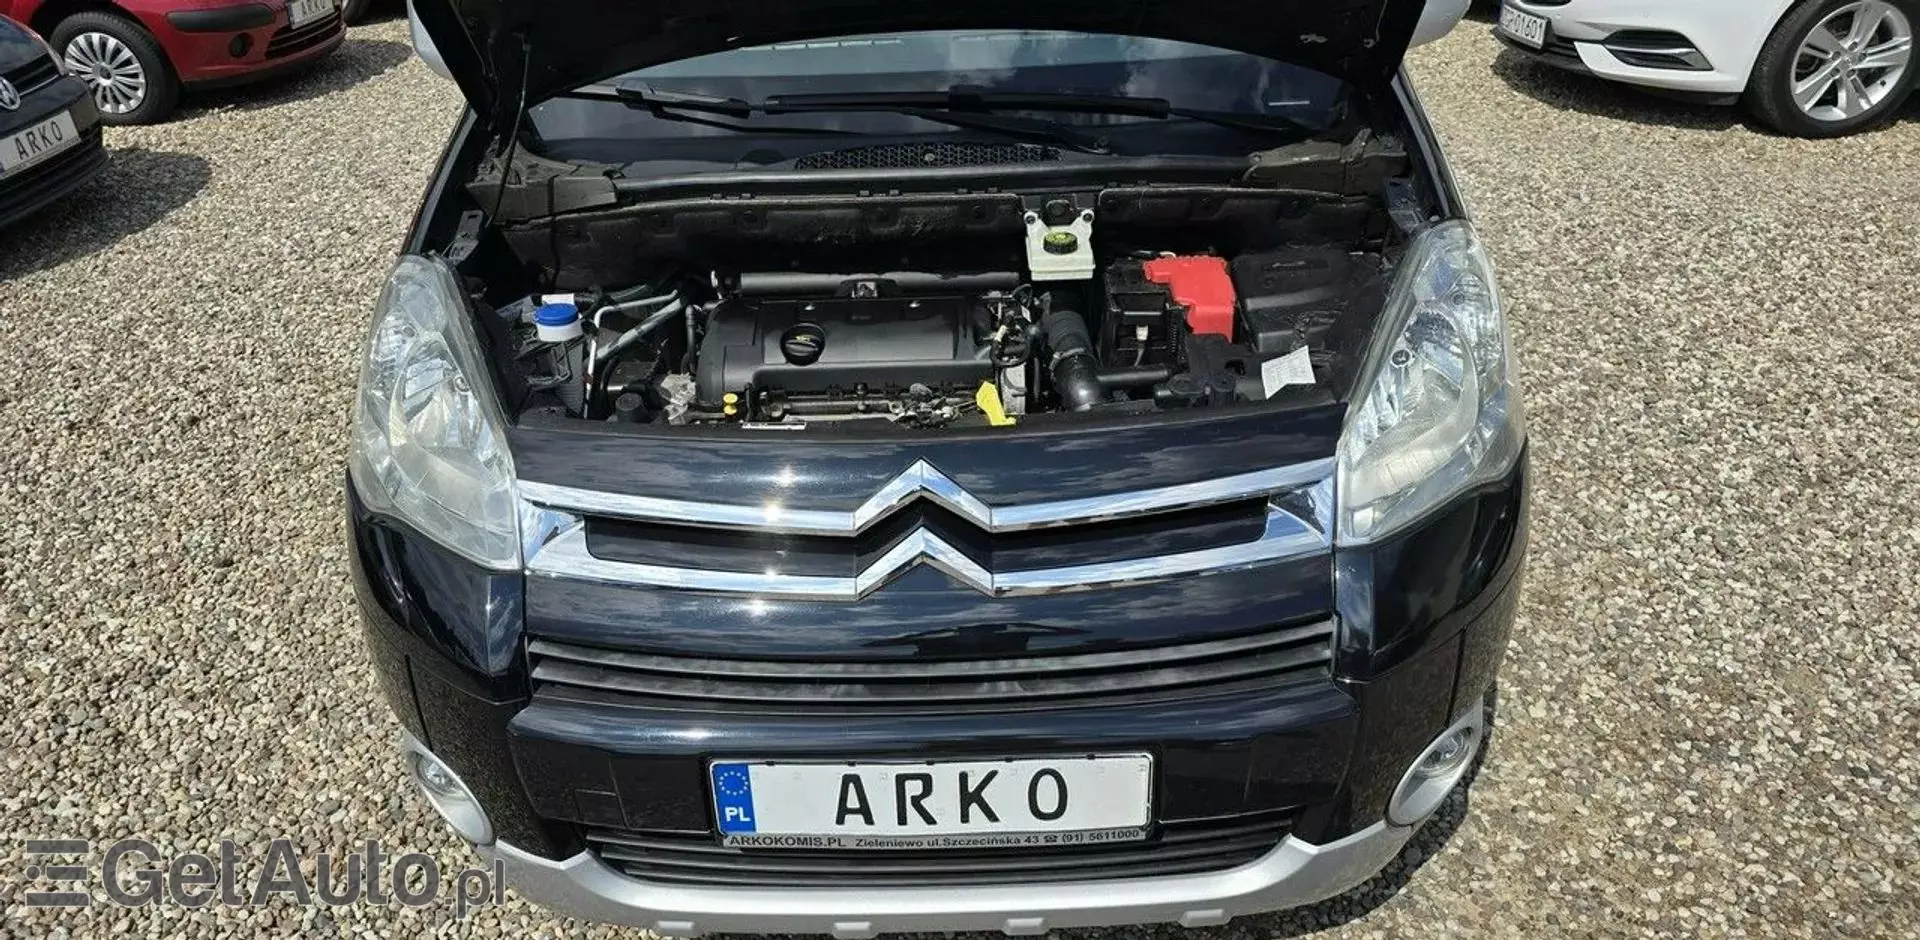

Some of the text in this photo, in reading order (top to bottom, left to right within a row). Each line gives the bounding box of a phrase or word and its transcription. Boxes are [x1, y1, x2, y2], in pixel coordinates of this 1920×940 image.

[14, 120, 63, 160] ARKO
[835, 768, 1068, 826] ARKO
[725, 806, 751, 822] PL
[729, 836, 847, 847] ARKOKOMIS.PL
[855, 838, 924, 847] Zieleniewo
[1024, 835, 1039, 845] 43
[1088, 829, 1140, 841] 5611000
